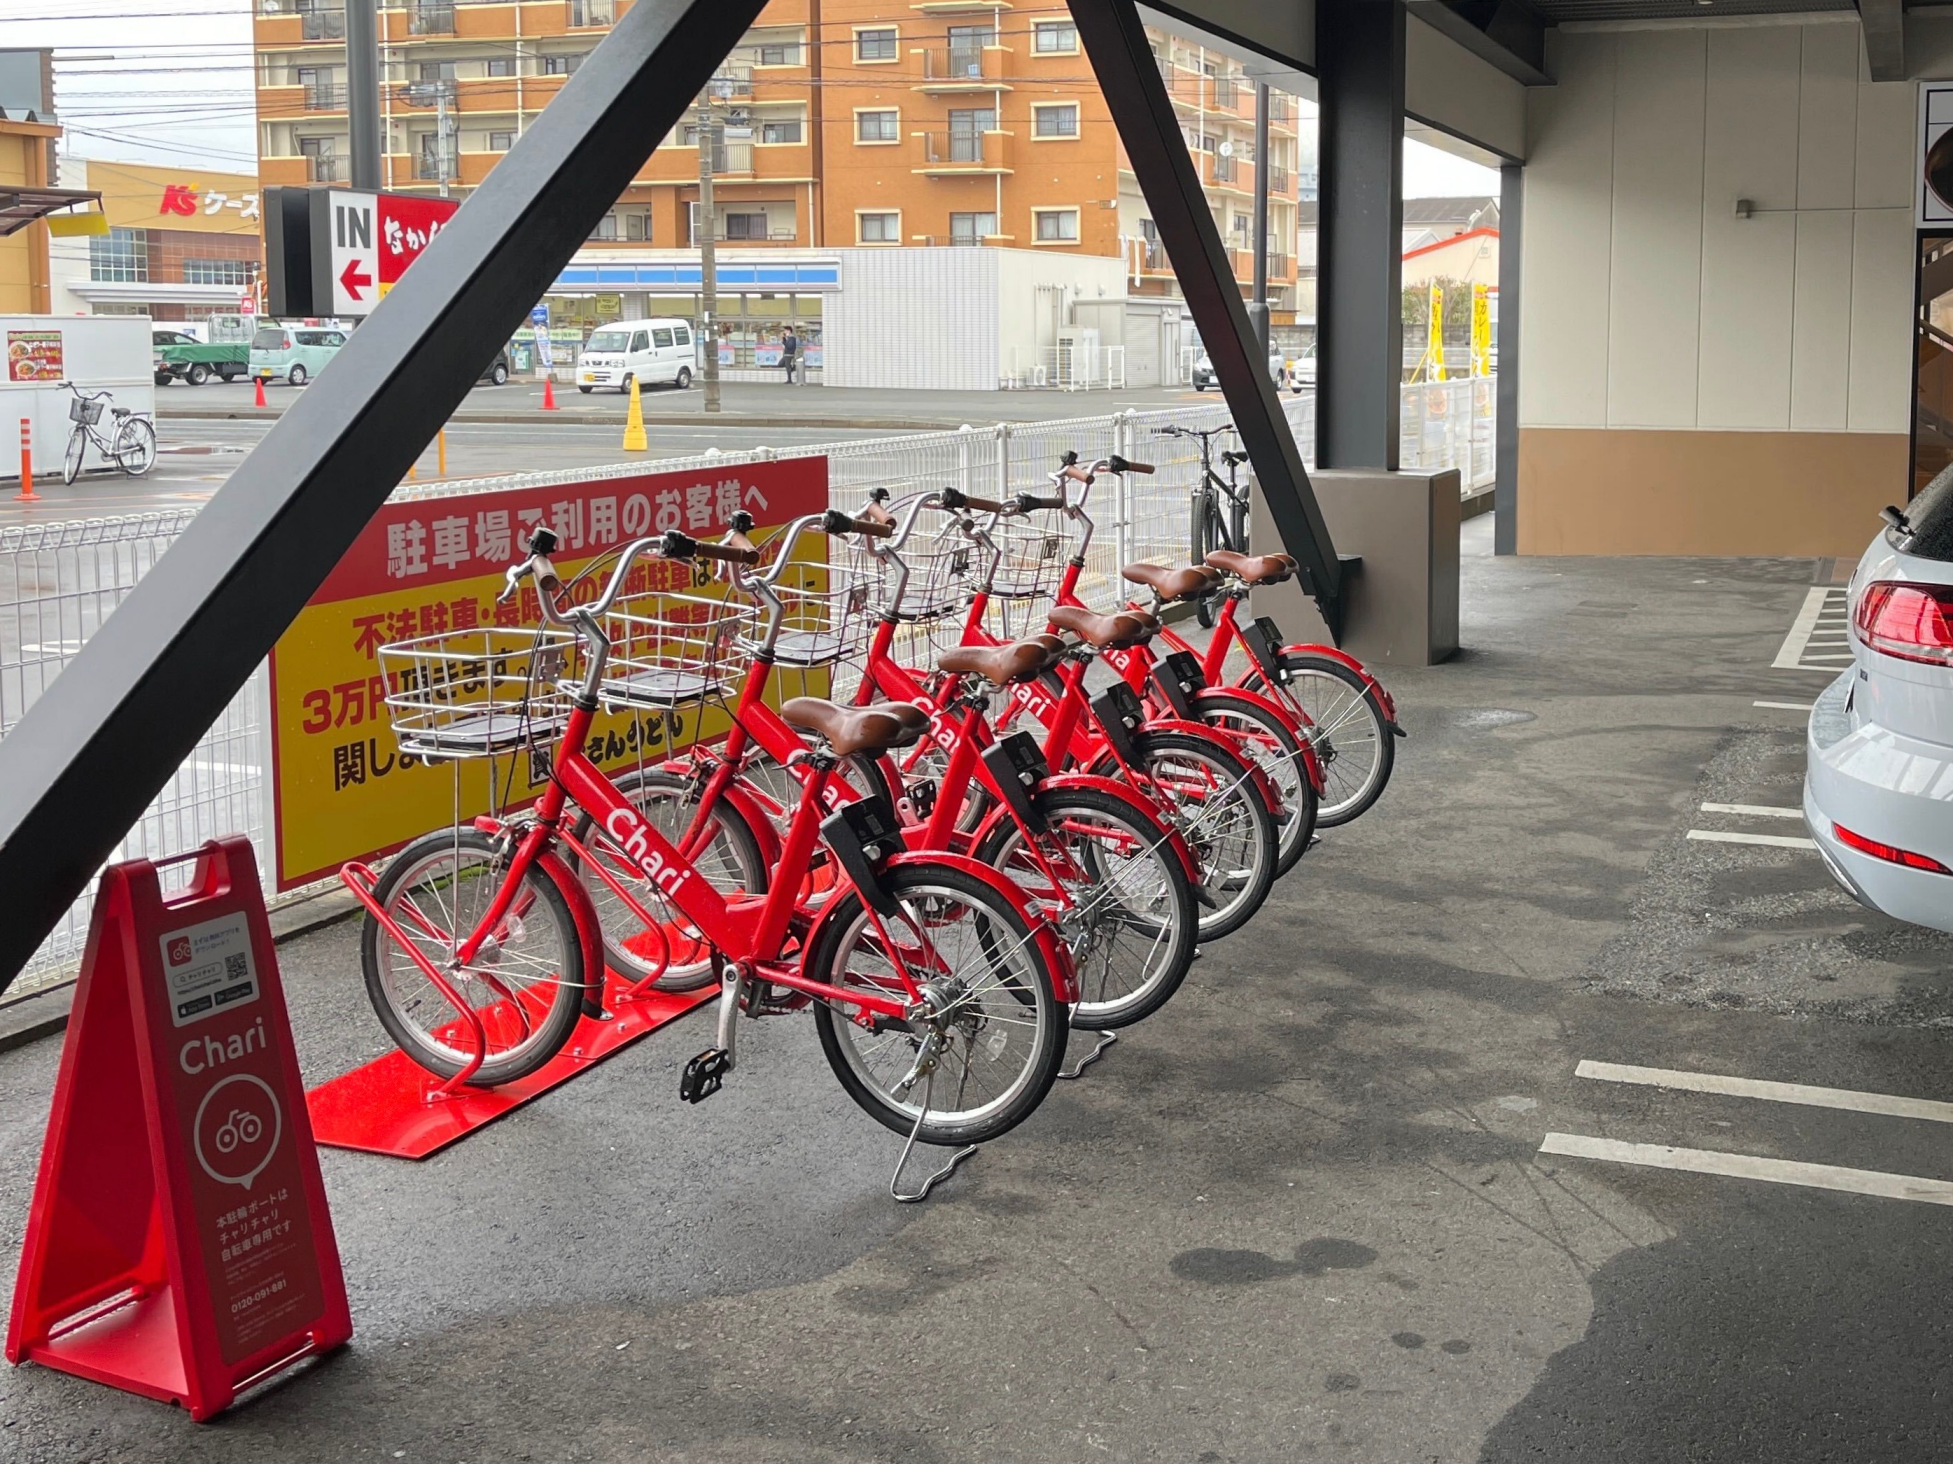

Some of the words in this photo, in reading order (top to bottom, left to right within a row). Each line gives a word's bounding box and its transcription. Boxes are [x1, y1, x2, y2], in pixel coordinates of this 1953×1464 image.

[336, 205, 371, 249] IN
[387, 479, 769, 579] 駐車場ご利用のお客様へ
[606, 808, 691, 896] Chari
[179, 1016, 267, 1075] Chari
[216, 1188, 289, 1228] 本駐輪ポートは
[219, 1208, 278, 1245] チャリチャリ
[221, 1219, 291, 1262] 自転車専用です
[231, 1278, 287, 1313] 0120-091-881
